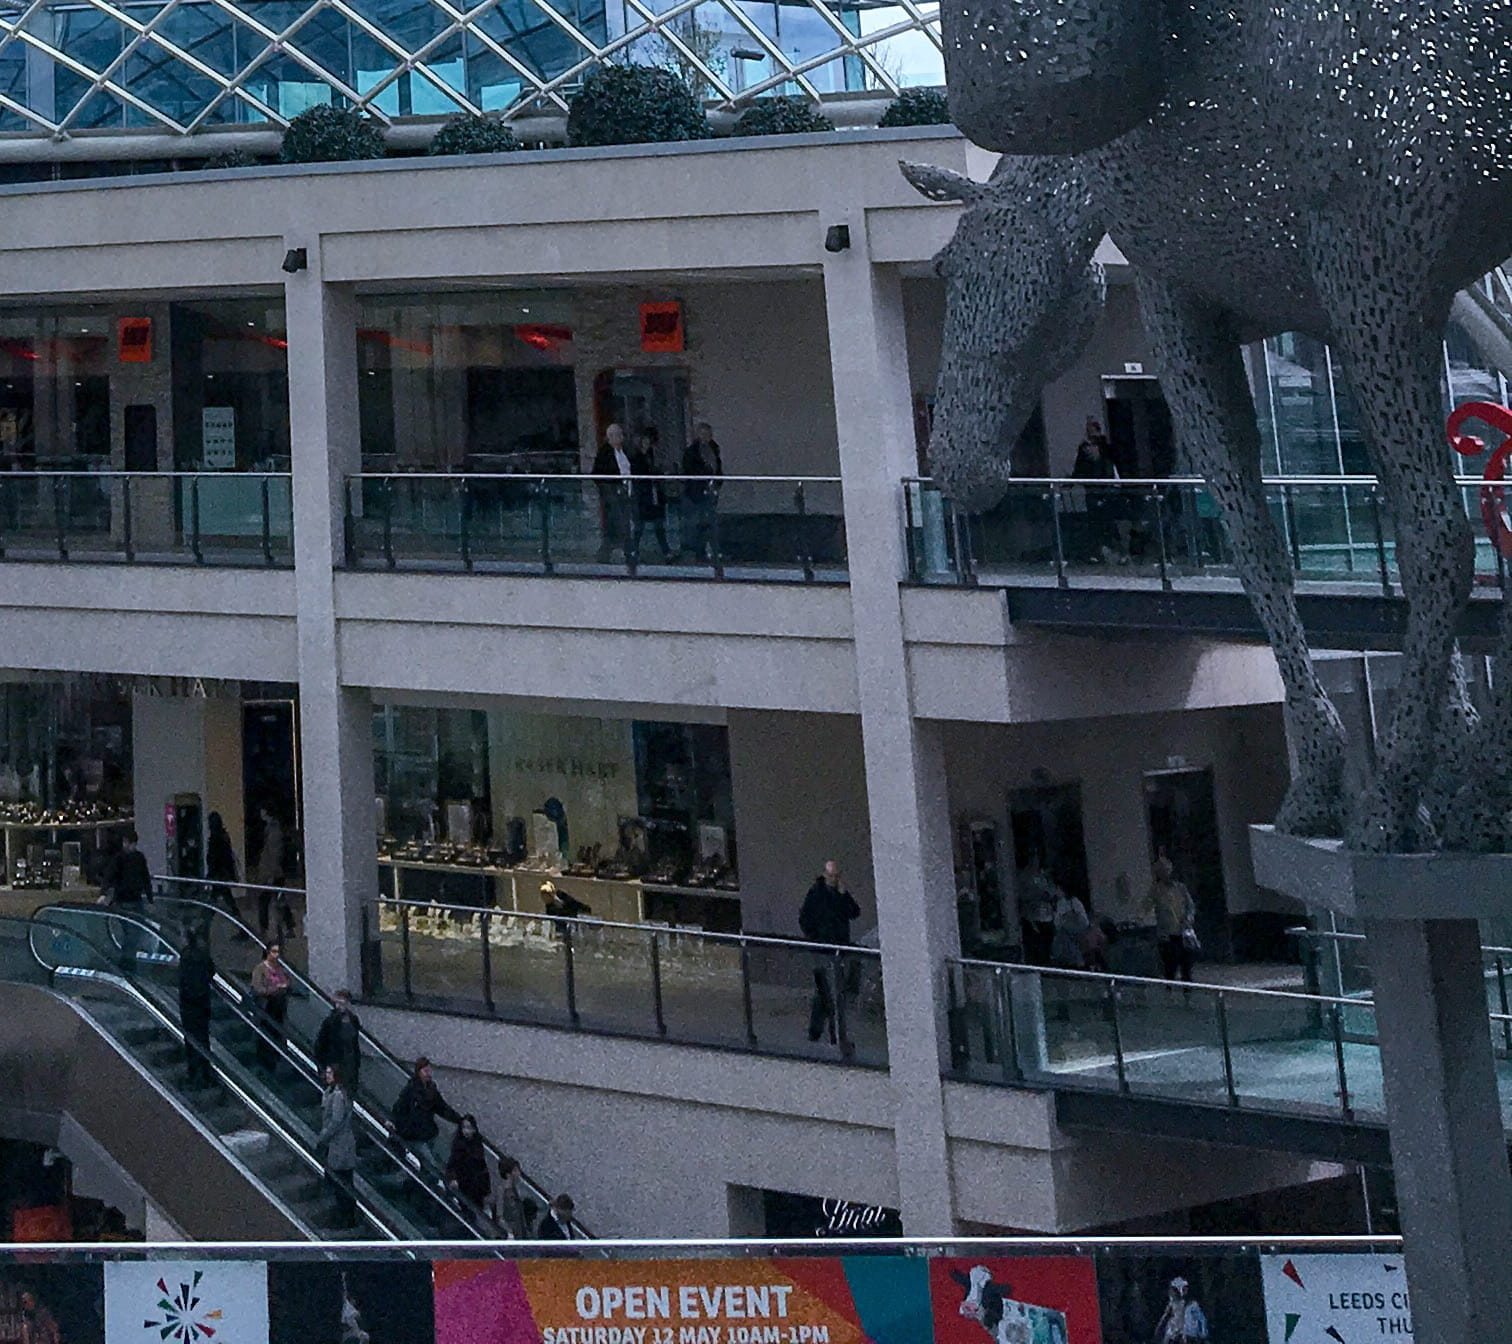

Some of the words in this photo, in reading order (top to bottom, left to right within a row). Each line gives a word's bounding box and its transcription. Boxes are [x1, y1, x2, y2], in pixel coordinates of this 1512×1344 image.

[575, 1286, 671, 1320] OPEN
[678, 1285, 793, 1319] EVENT
[1329, 1293, 1386, 1310] LEEDS
[1391, 1293, 1409, 1310] CI
[543, 1326, 647, 1344] SATURDAY
[653, 1327, 675, 1344] 12
[679, 1326, 722, 1344] MAY
[727, 1325, 830, 1344] 10AM-1PM
[1376, 1317, 1415, 1335] THU
